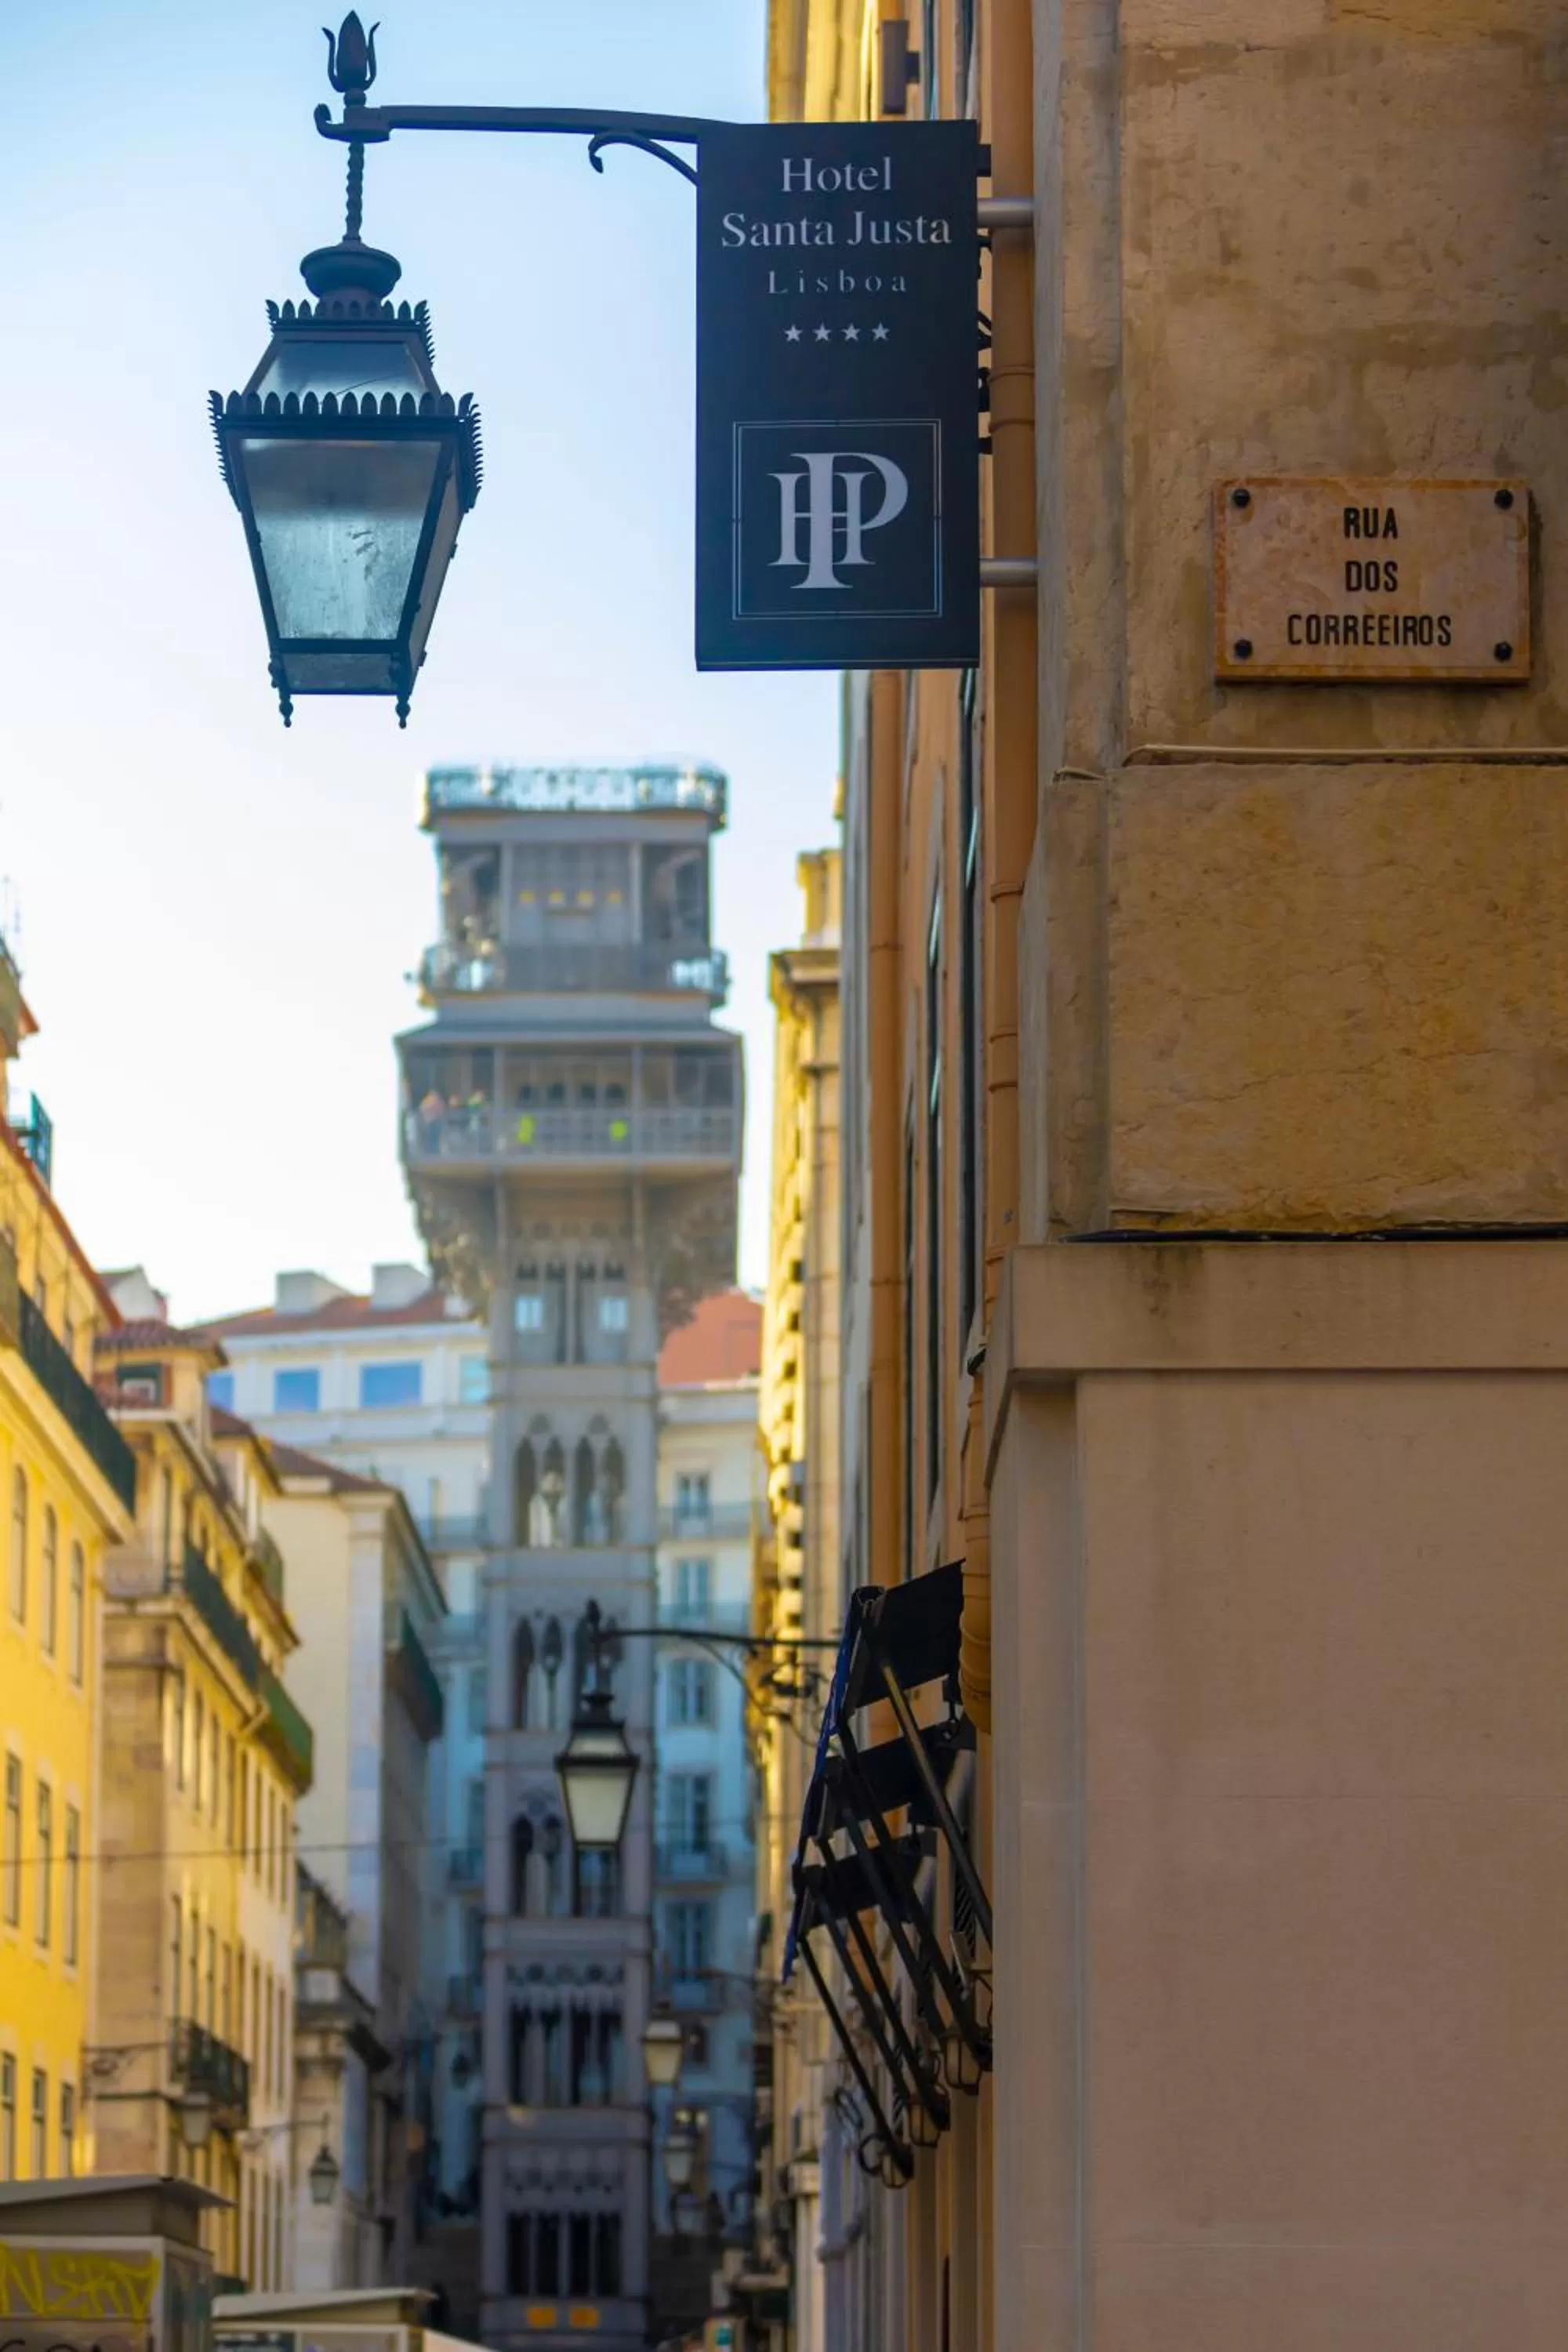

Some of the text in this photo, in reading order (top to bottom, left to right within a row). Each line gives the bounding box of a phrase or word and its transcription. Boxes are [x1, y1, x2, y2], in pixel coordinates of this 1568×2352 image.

[781, 156, 892, 192] Hotel
[721, 210, 953, 248] Santa Justa
[768, 270, 907, 294] Lisboa
[1343, 506, 1399, 540] RUA
[1345, 560, 1399, 593] DOS
[1287, 613, 1452, 647] CORREEIROS
